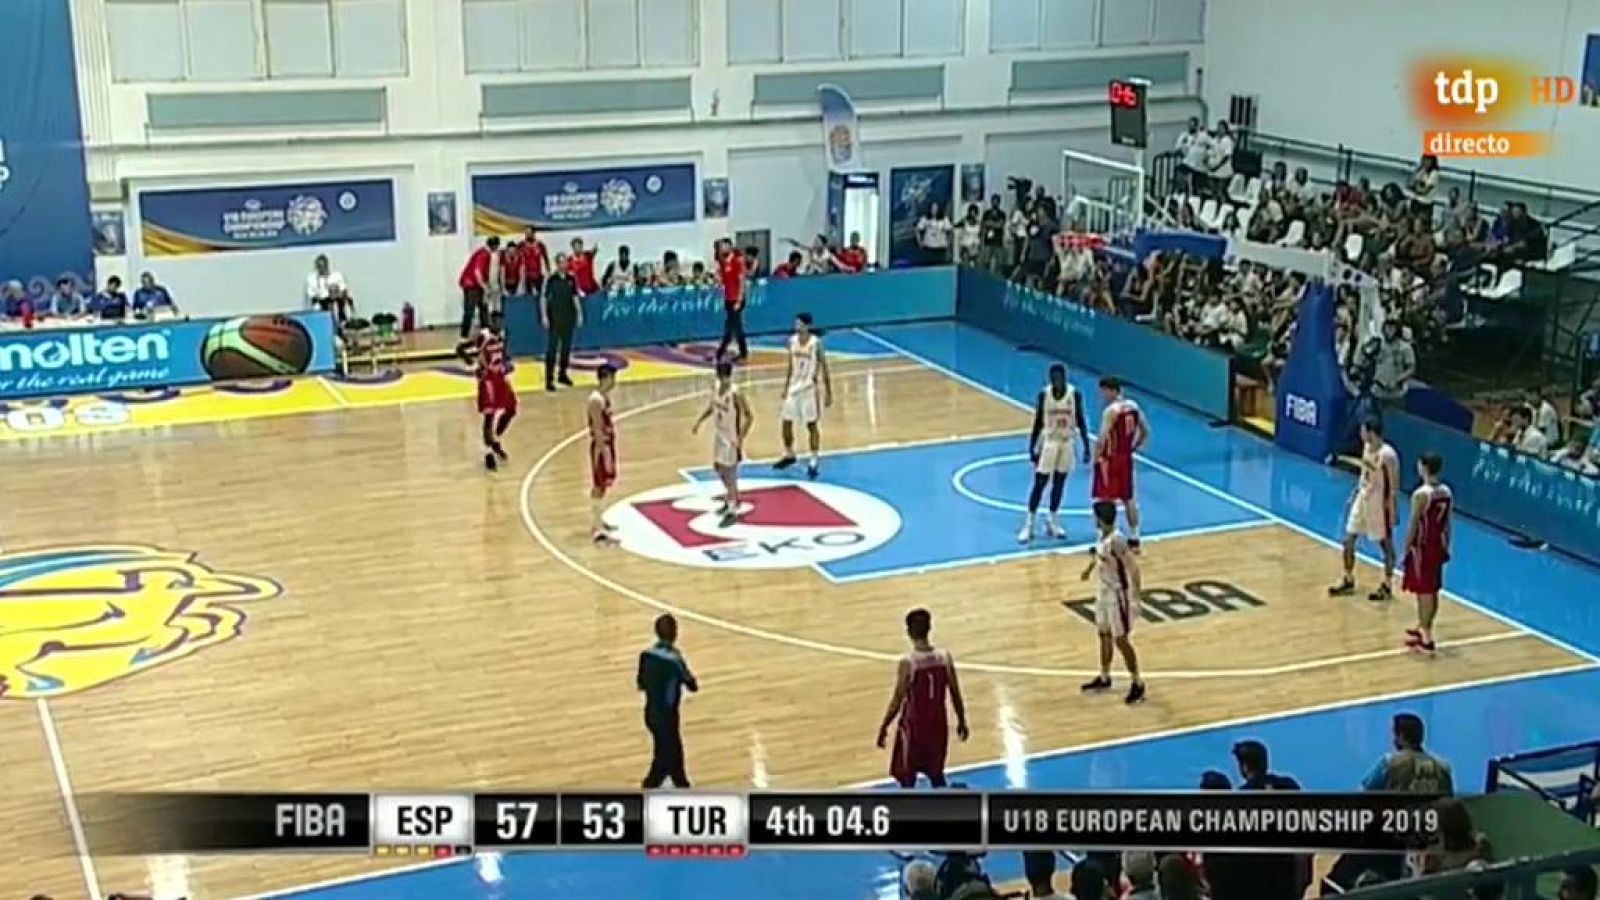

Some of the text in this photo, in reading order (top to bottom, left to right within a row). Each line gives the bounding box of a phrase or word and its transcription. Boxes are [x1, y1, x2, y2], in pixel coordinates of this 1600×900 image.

[17, 371, 53, 390] the
[58, 367, 108, 386] real
[1286, 392, 1317, 426] FIBA
[703, 531, 865, 562] EKO
[928, 673, 934, 699] 1
